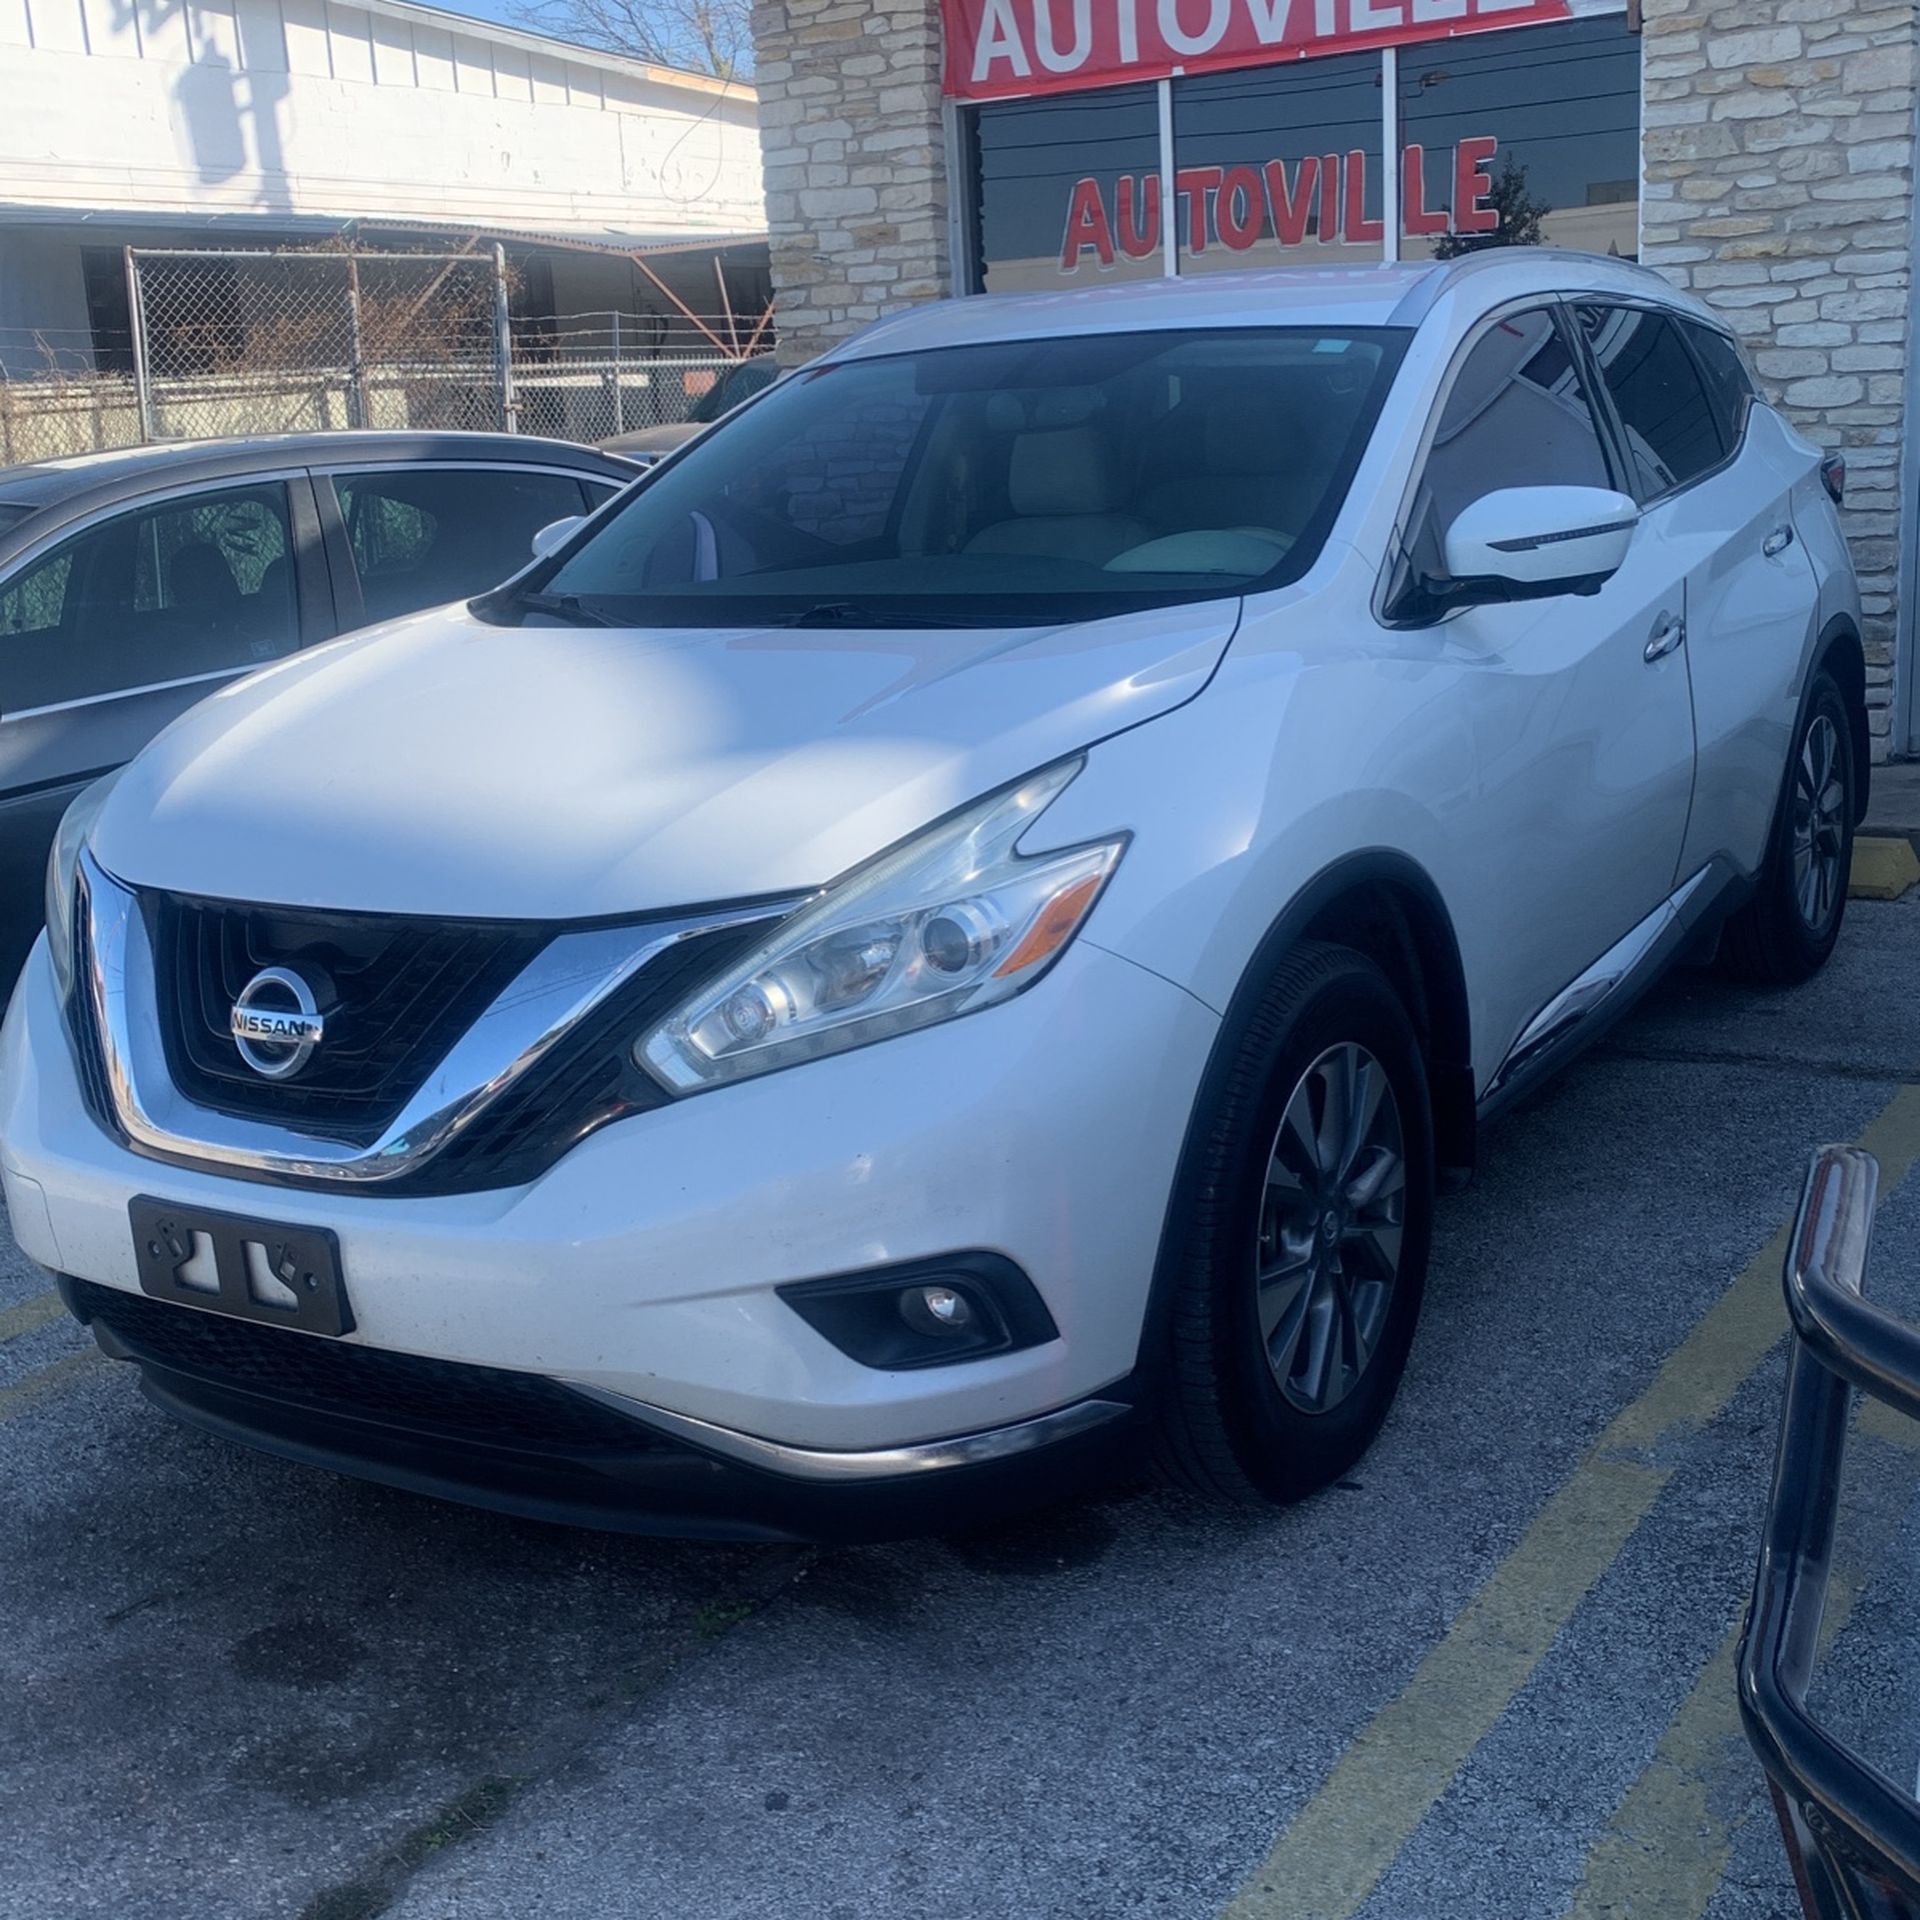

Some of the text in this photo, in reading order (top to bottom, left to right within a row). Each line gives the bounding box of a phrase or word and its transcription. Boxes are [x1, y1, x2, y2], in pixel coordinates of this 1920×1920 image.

[971, 0, 1536, 82] AUTOV
[1059, 136, 1498, 274] AUTOVILLE
[232, 1012, 306, 1036] NISSAN
